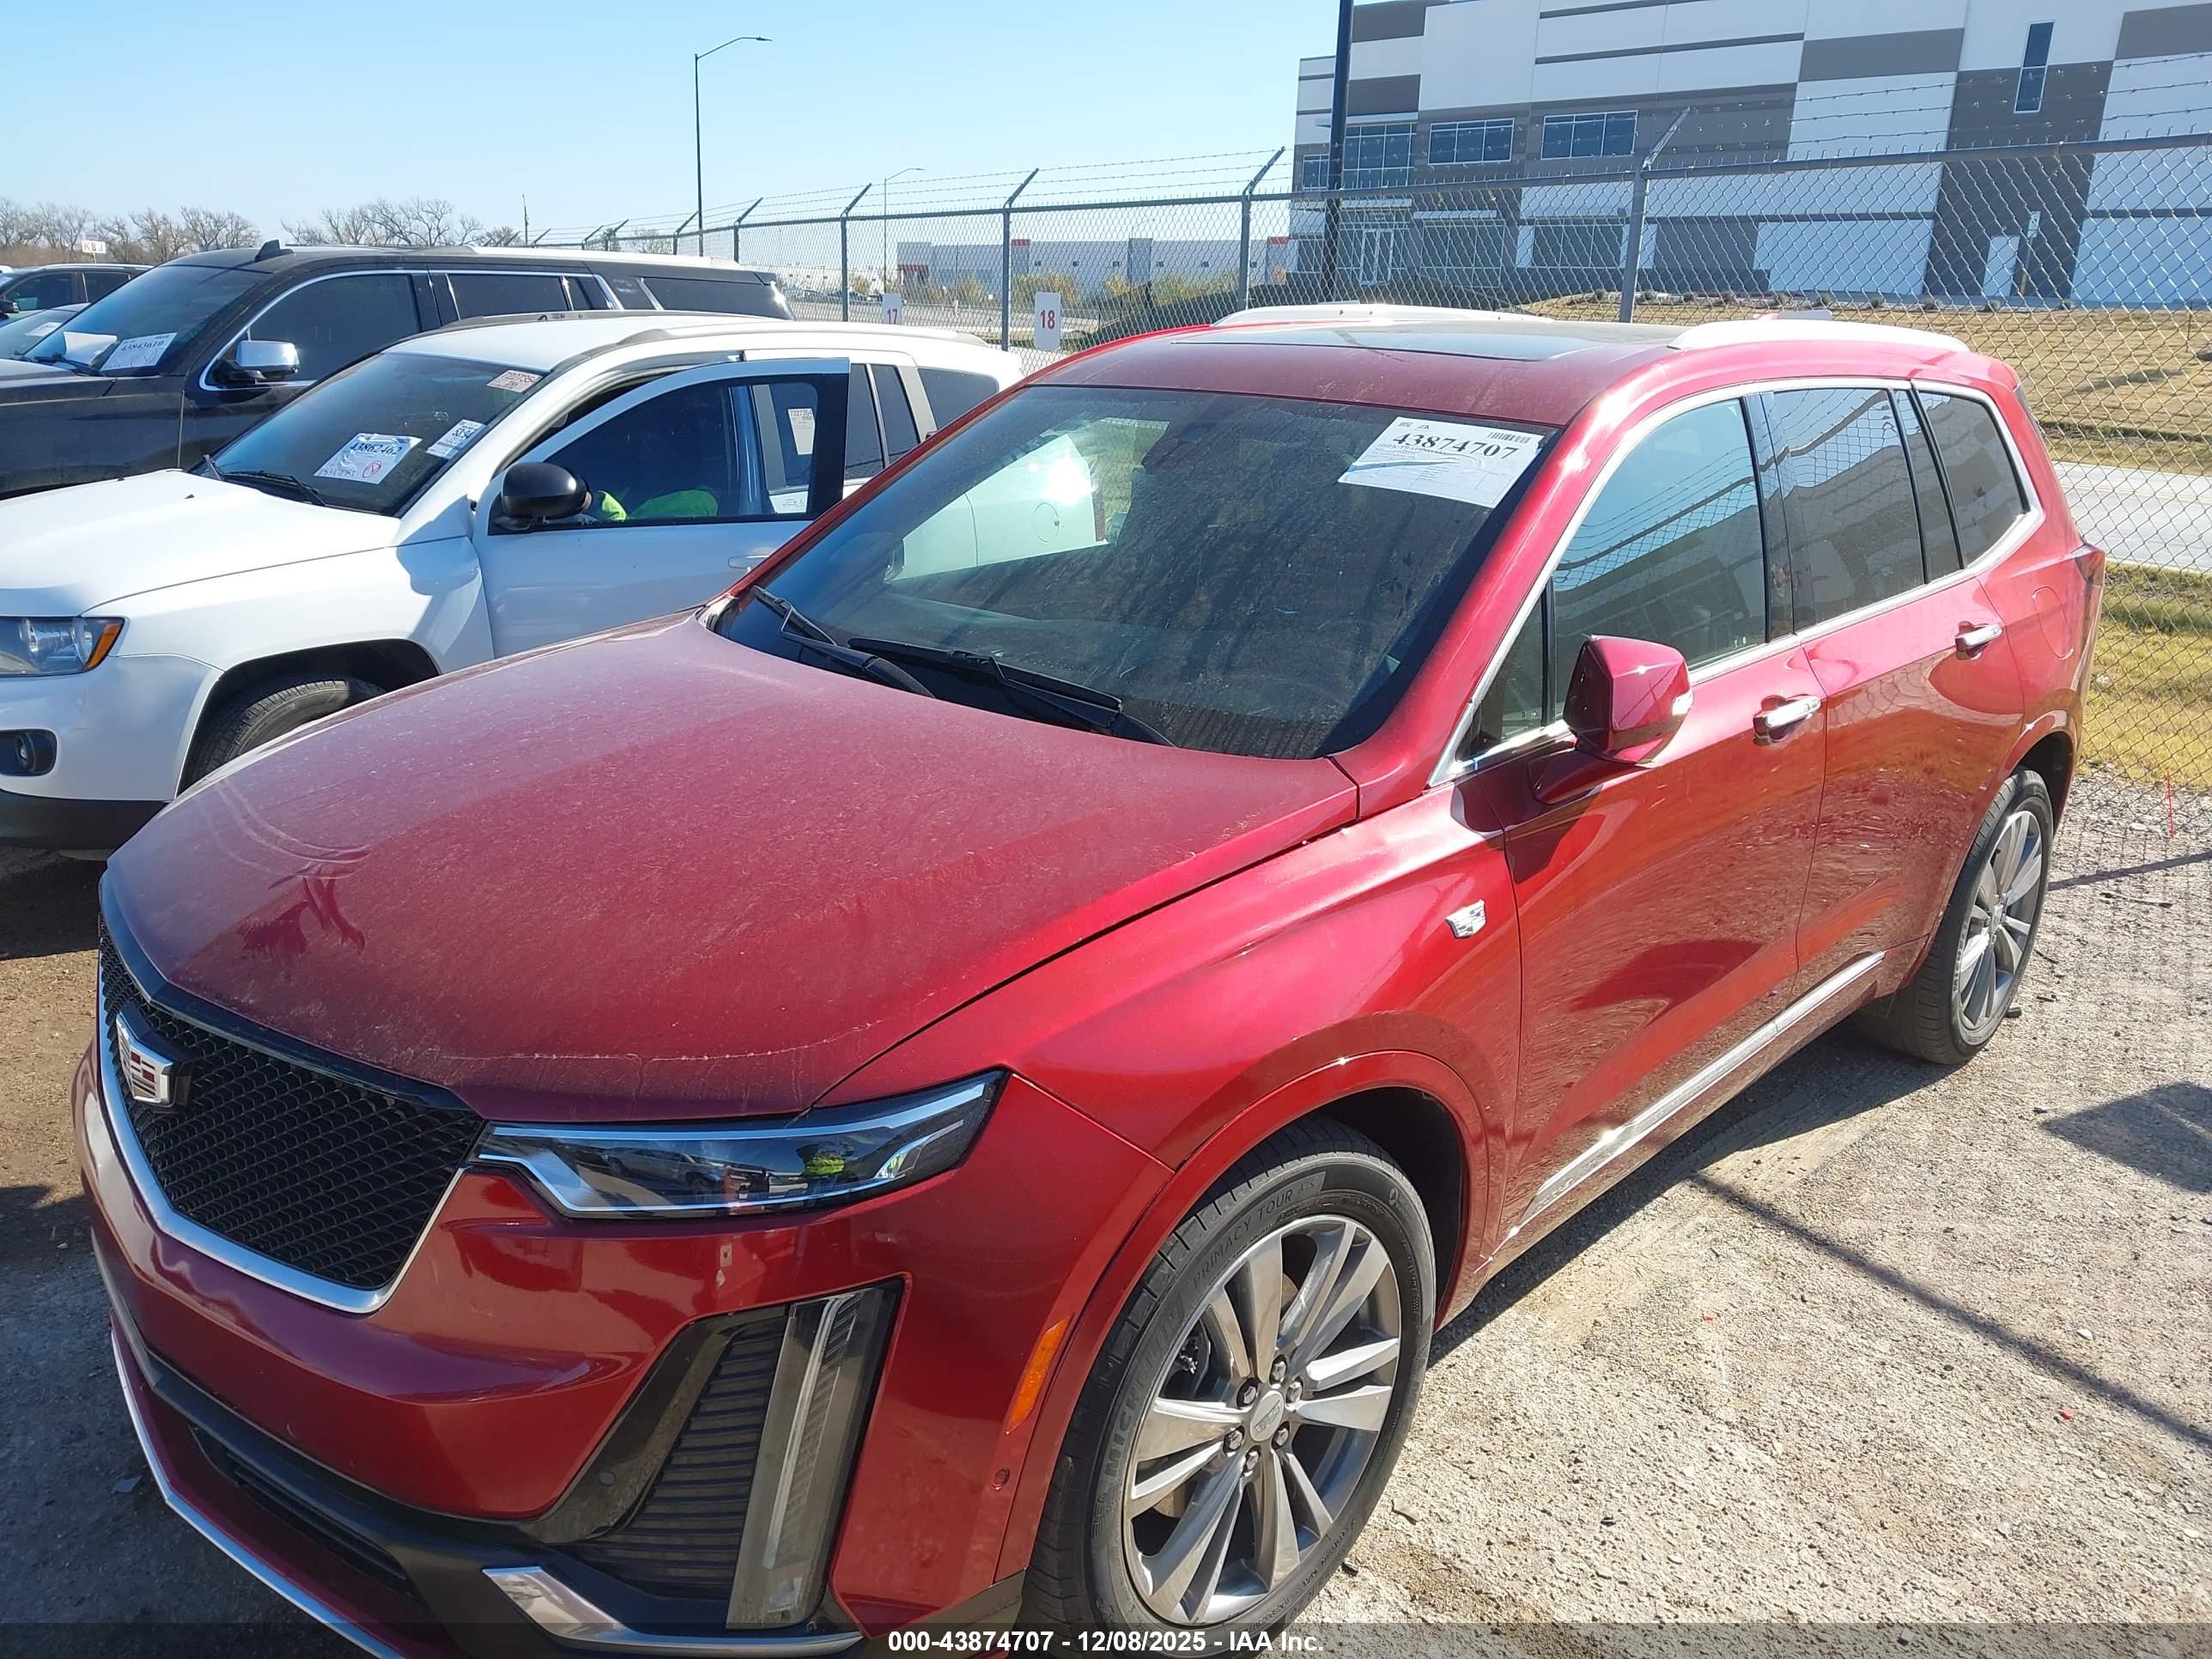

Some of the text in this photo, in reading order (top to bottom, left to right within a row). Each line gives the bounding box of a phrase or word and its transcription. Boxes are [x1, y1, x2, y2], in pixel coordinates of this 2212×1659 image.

[887, 308, 898, 324] 17
[1040, 309, 1055, 330] 18
[1393, 432, 1519, 459] 43874707
[1194, 1215, 1252, 1288] PRIMACY
[1257, 1188, 1293, 1220] TOUR
